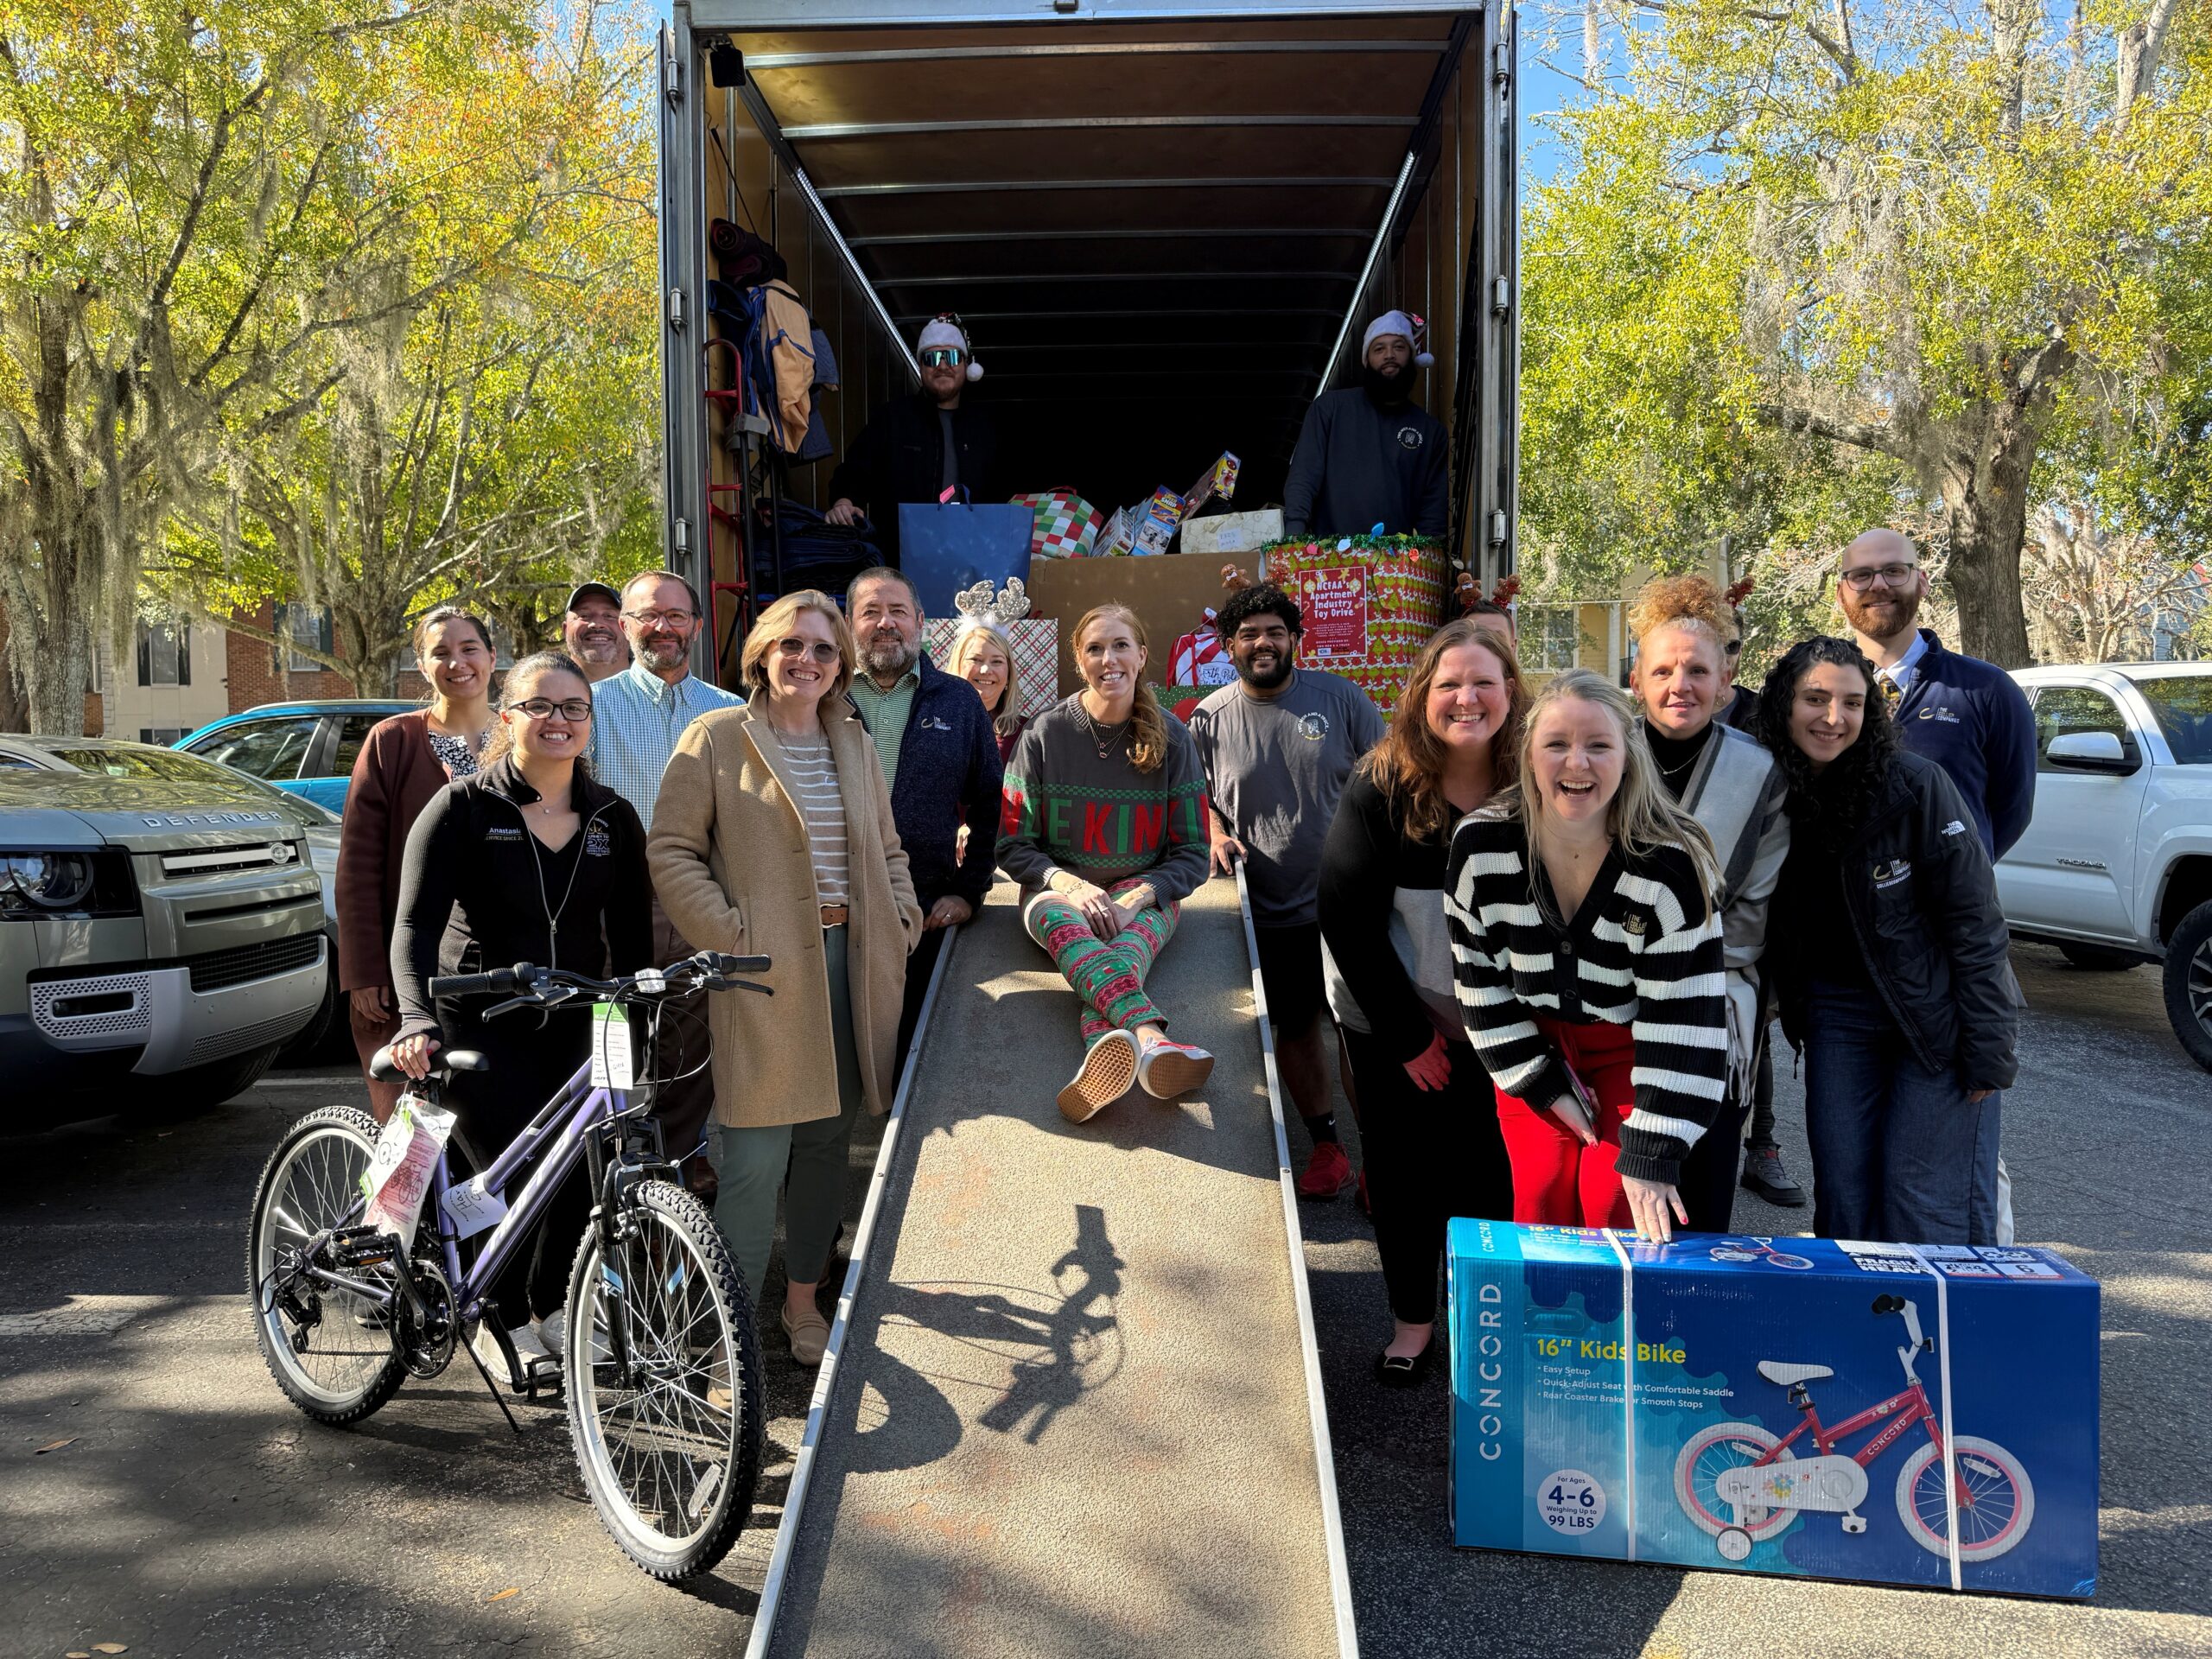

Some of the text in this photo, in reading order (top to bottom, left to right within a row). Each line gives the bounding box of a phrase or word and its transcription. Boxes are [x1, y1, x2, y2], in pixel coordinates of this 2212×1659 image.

[1310, 590, 1357, 602] Apartment
[1314, 600, 1352, 610] Industry
[1313, 610, 1328, 620] Toy
[142, 810, 283, 828] DEFENDER
[1084, 801, 1165, 855] KIN
[587, 839, 610, 850] 2X
[1478, 1222, 1495, 1252] CONCORD
[1560, 1228, 1597, 1236] Kids
[2015, 1264, 2035, 1273] 6
[1580, 1340, 1627, 1360] Kids
[1637, 1343, 1687, 1364] Bike
[1479, 1284, 1502, 1461] CONCORD
[1543, 1365, 1591, 1376] Easy Setup
[1543, 1377, 1600, 1390] Quick-Adjust
[1602, 1382, 1622, 1390] Seat
[1644, 1384, 1700, 1395] Comfortable
[1702, 1387, 1734, 1397] Saddle
[1543, 1391, 1562, 1400] Rear
[1564, 1392, 1598, 1402] Coaster
[1599, 1394, 1624, 1403] Brake
[1642, 1397, 1676, 1408] Smooth
[1678, 1400, 1703, 1410] Stops
[1867, 1419, 1906, 1455] CONCORD
[1548, 1485, 1595, 1508] 4-6
[1547, 1505, 1578, 1514] Weighing
[1548, 1515, 1594, 1529] 99 LBS
